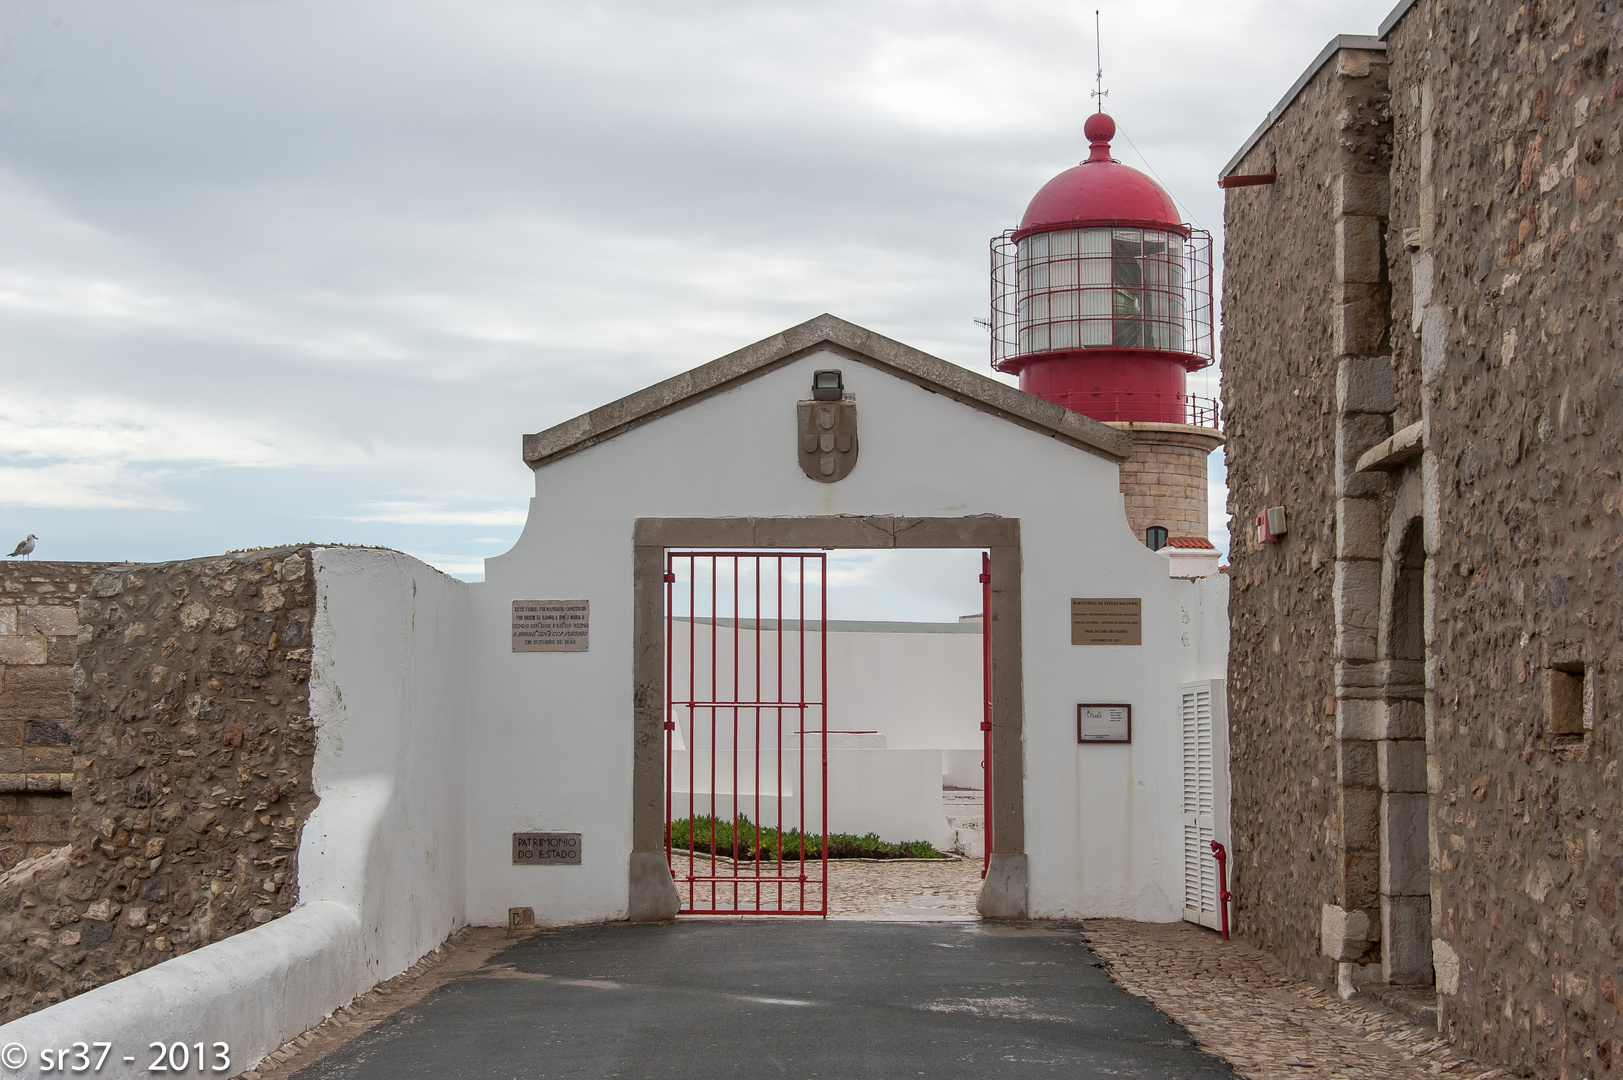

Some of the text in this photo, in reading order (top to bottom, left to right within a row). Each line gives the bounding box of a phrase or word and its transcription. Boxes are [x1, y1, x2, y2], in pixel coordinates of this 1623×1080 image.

[518, 838, 576, 847] PATRIMONIO
[518, 850, 576, 859] DO ESTADO
